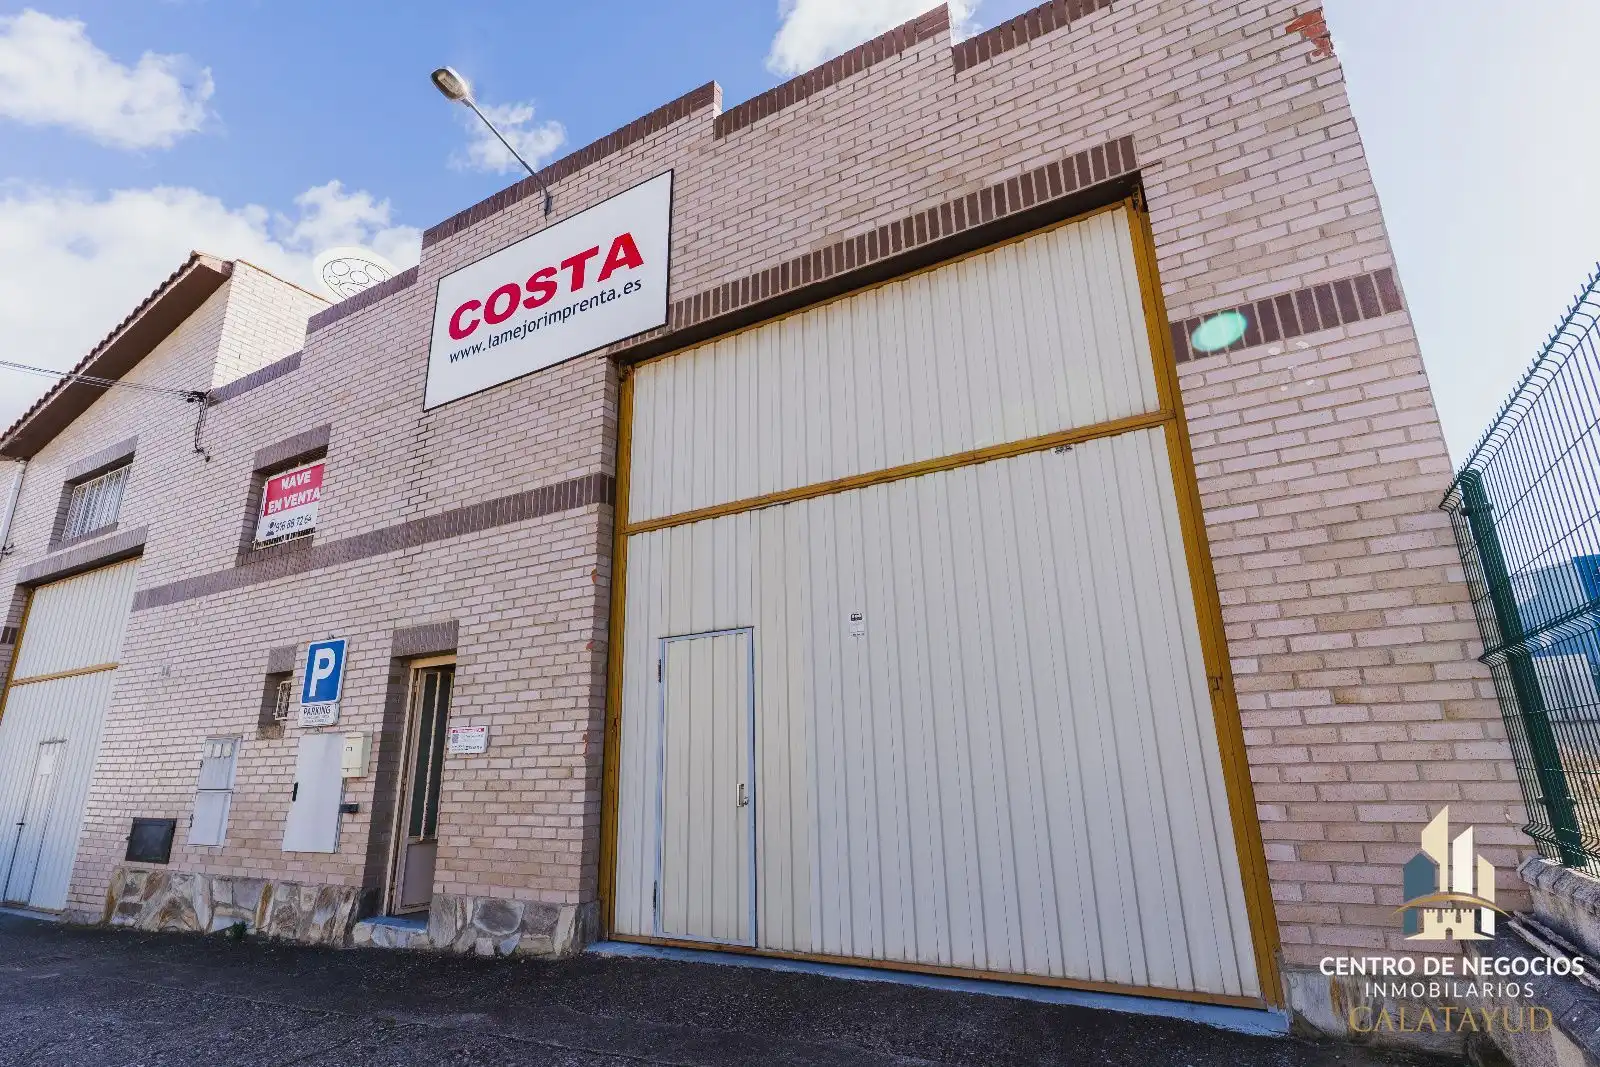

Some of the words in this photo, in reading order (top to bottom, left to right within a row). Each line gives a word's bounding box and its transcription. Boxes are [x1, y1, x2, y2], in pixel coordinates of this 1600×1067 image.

[449, 232, 644, 340] COSTA
[449, 278, 642, 364] www.lamejorimprenta.es
[281, 470, 312, 490] NAVE
[267, 500, 283, 514] EN
[283, 487, 321, 508] VENTA
[309, 648, 335, 697] P
[303, 705, 331, 715] PARKING
